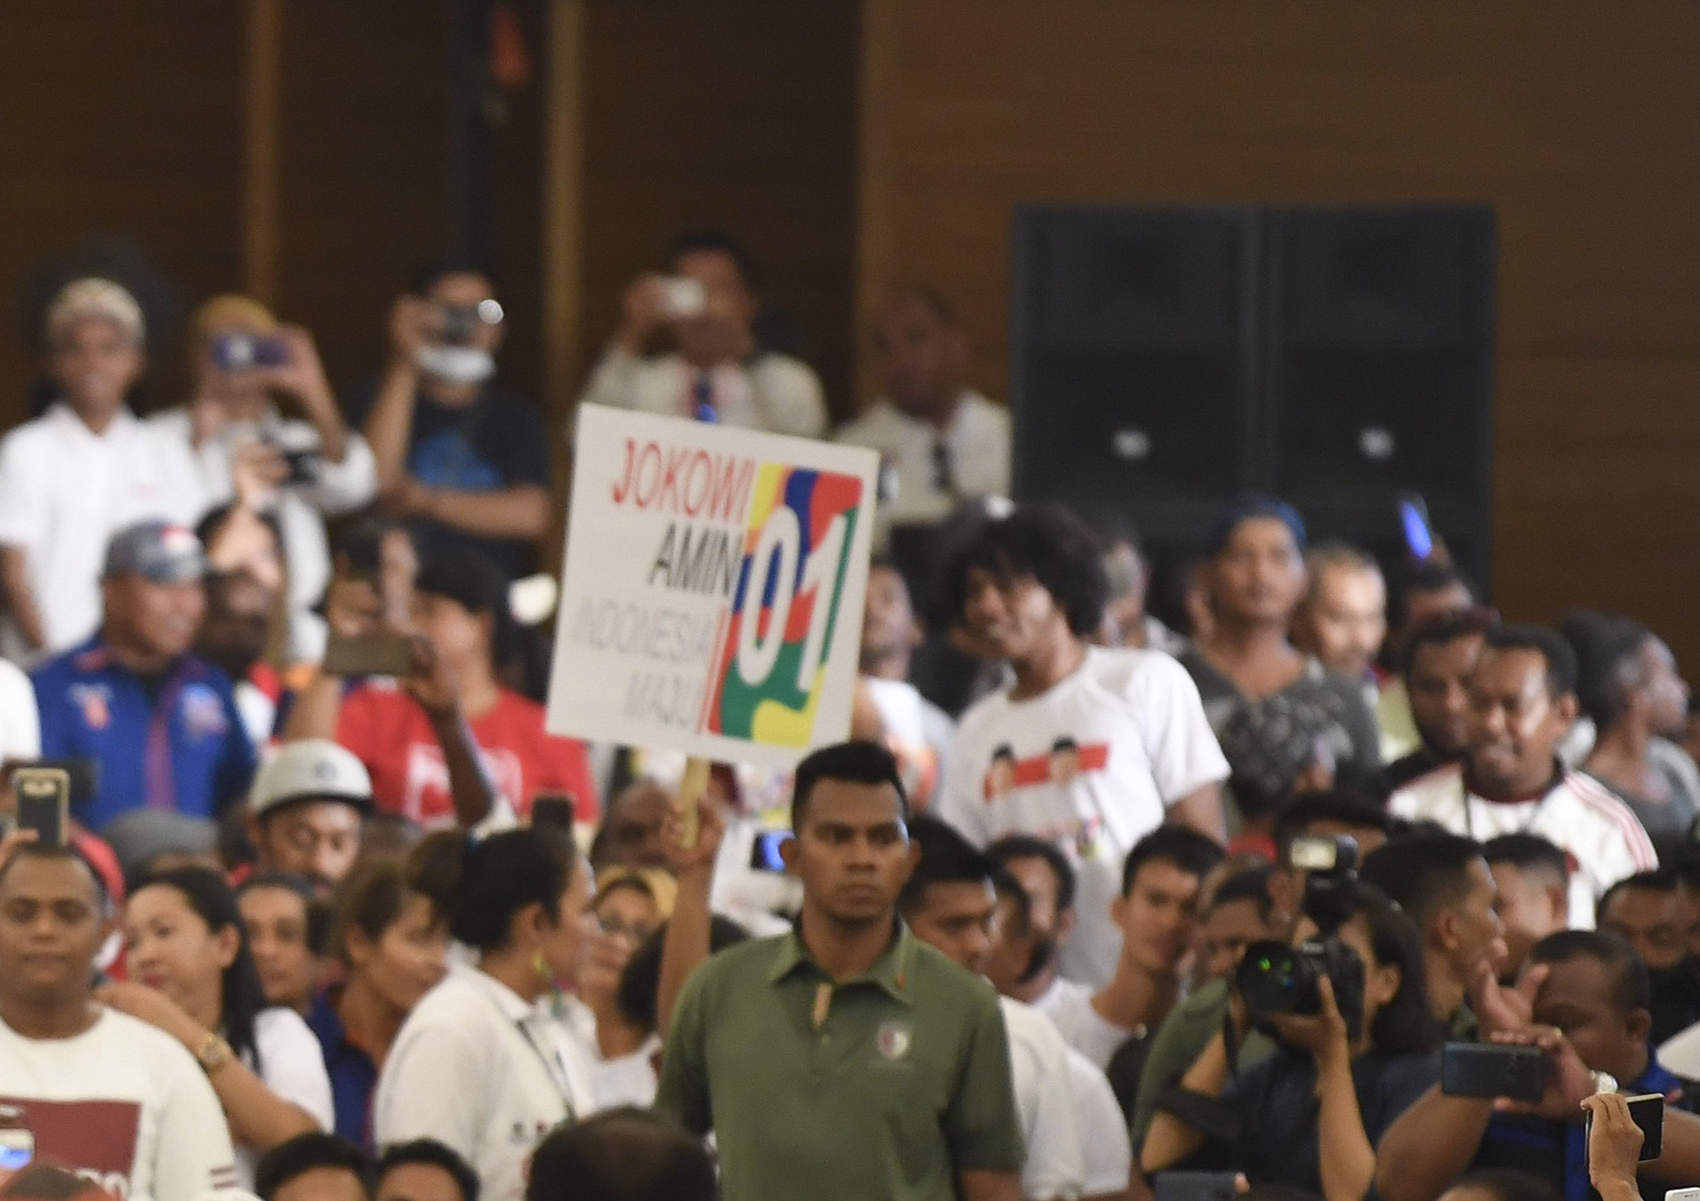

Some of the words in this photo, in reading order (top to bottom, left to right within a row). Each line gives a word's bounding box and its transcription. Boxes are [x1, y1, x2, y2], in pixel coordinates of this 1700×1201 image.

[612, 437, 756, 523] JOKOWI
[648, 522, 743, 597] AMIN
[737, 505, 848, 691] 01
